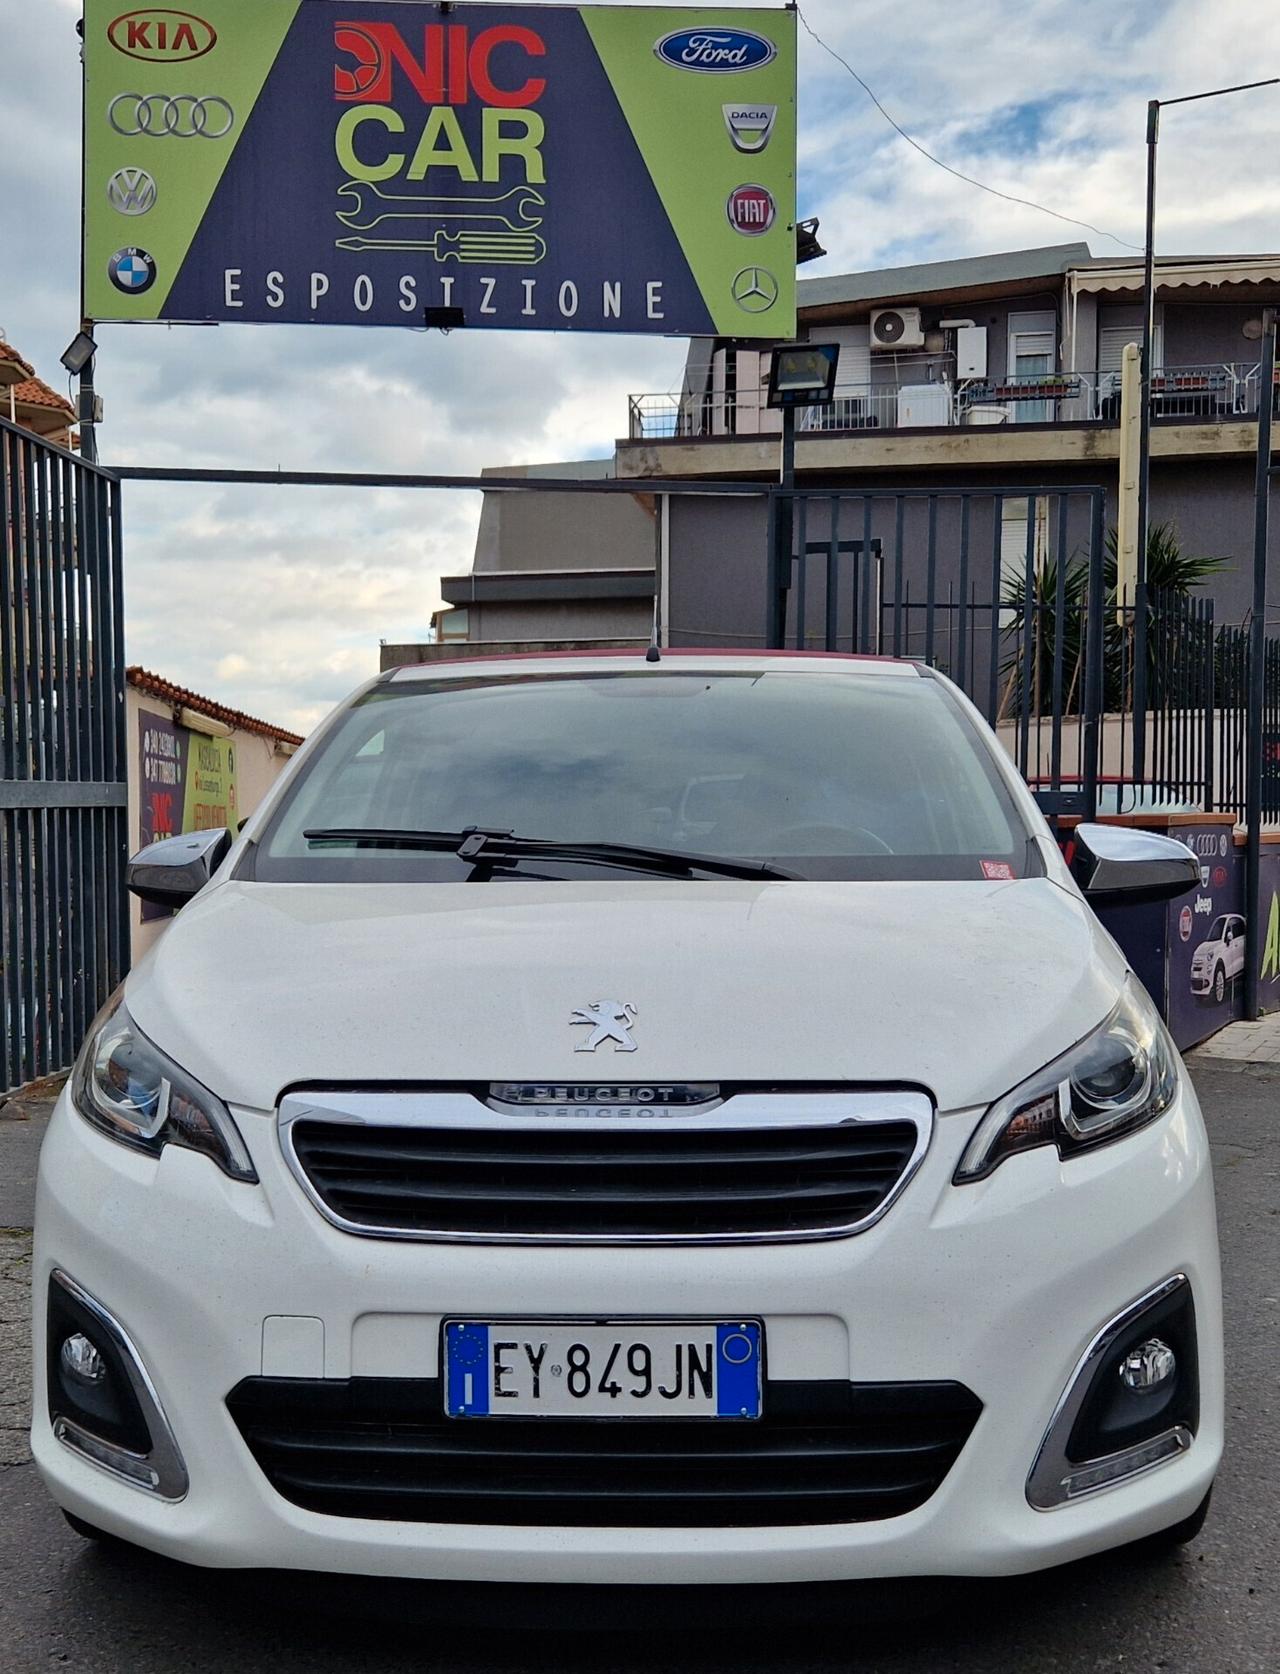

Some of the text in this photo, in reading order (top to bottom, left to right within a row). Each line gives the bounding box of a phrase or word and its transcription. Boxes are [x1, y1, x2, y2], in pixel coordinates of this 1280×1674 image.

[126, 20, 198, 51] KIA
[681, 34, 748, 63] Ford
[731, 111, 768, 120] DACIA
[335, 104, 546, 183] CAR
[737, 199, 766, 223] FIAT
[112, 247, 153, 264] BMW
[224, 268, 665, 320] ESPOSIZIONE
[1195, 894, 1212, 916] Jeep
[533, 1087, 674, 1102] PEUGEOT
[493, 1342, 548, 1399] EY
